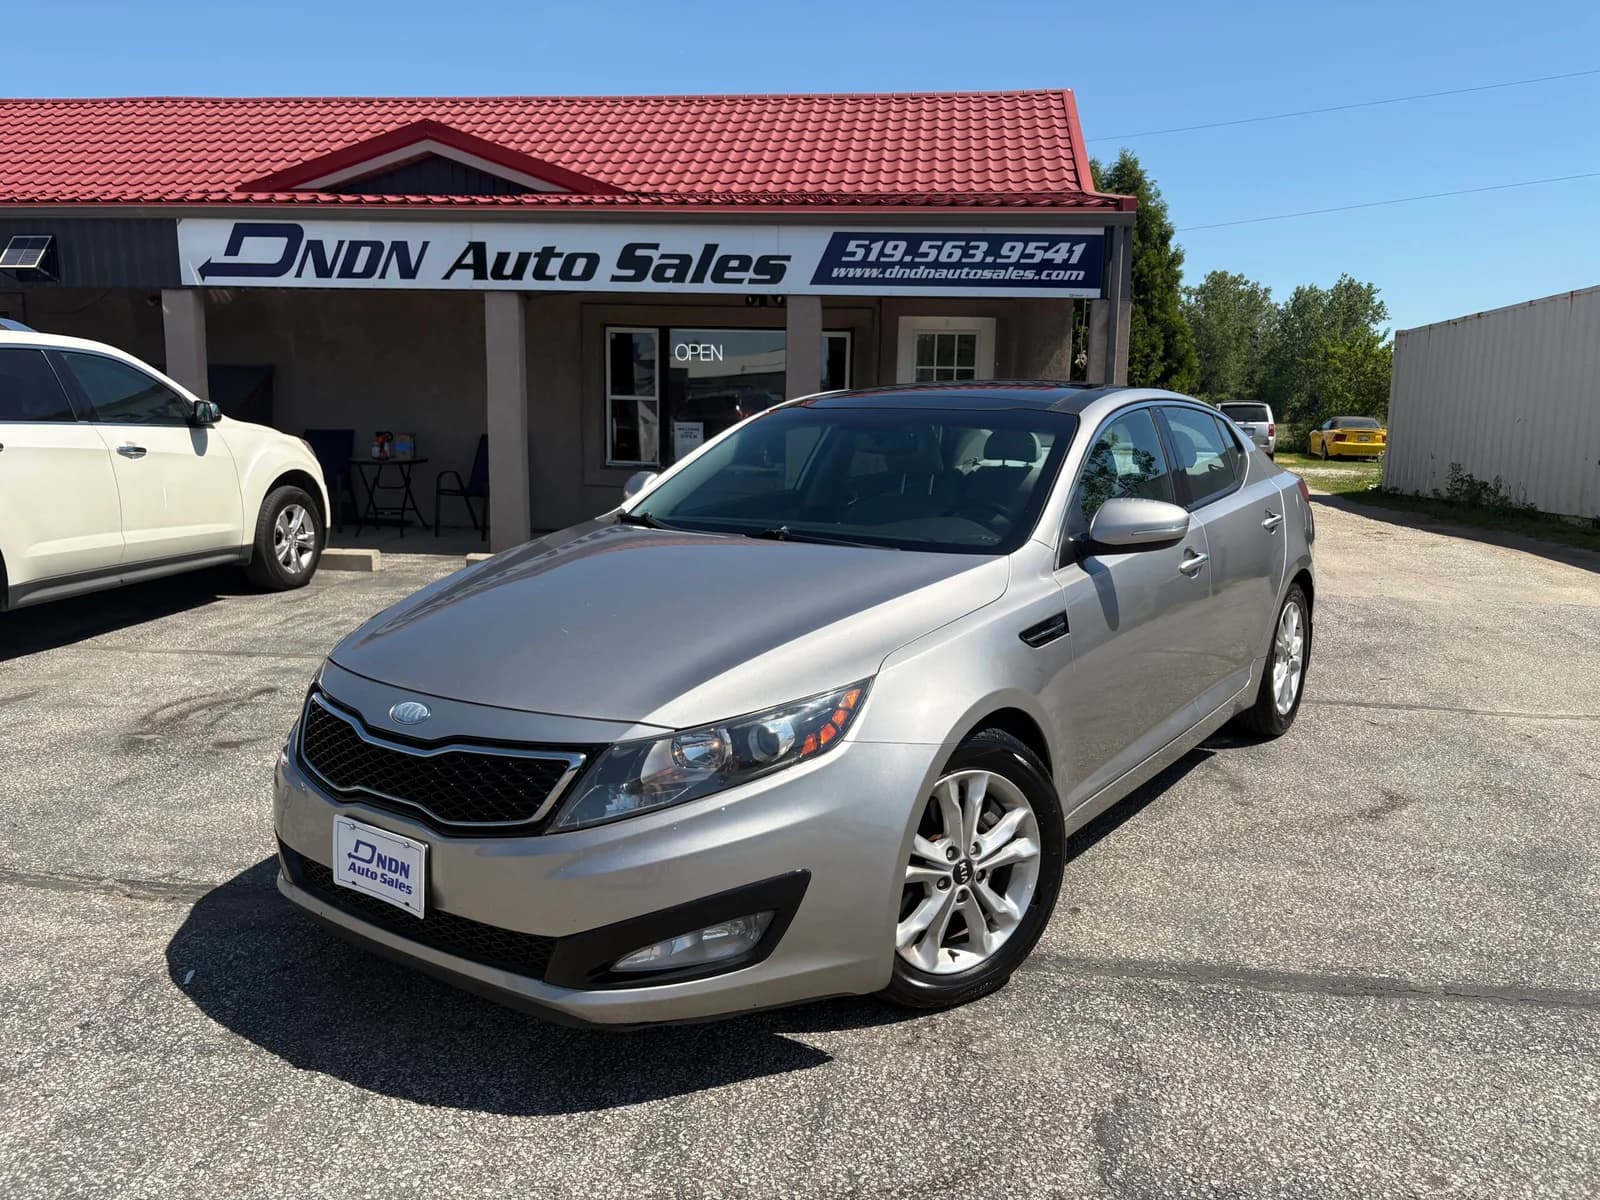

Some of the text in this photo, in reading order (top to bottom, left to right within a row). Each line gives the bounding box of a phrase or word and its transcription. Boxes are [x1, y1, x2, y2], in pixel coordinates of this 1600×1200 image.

[198, 222, 792, 285] DNDN Auto Sales
[841, 239, 1087, 264] 519.563.9541
[831, 265, 1086, 281] www.dndnautosales.com
[674, 343, 724, 362] OPEN
[347, 839, 410, 879] DNDN
[348, 861, 413, 895] Auto Sales
